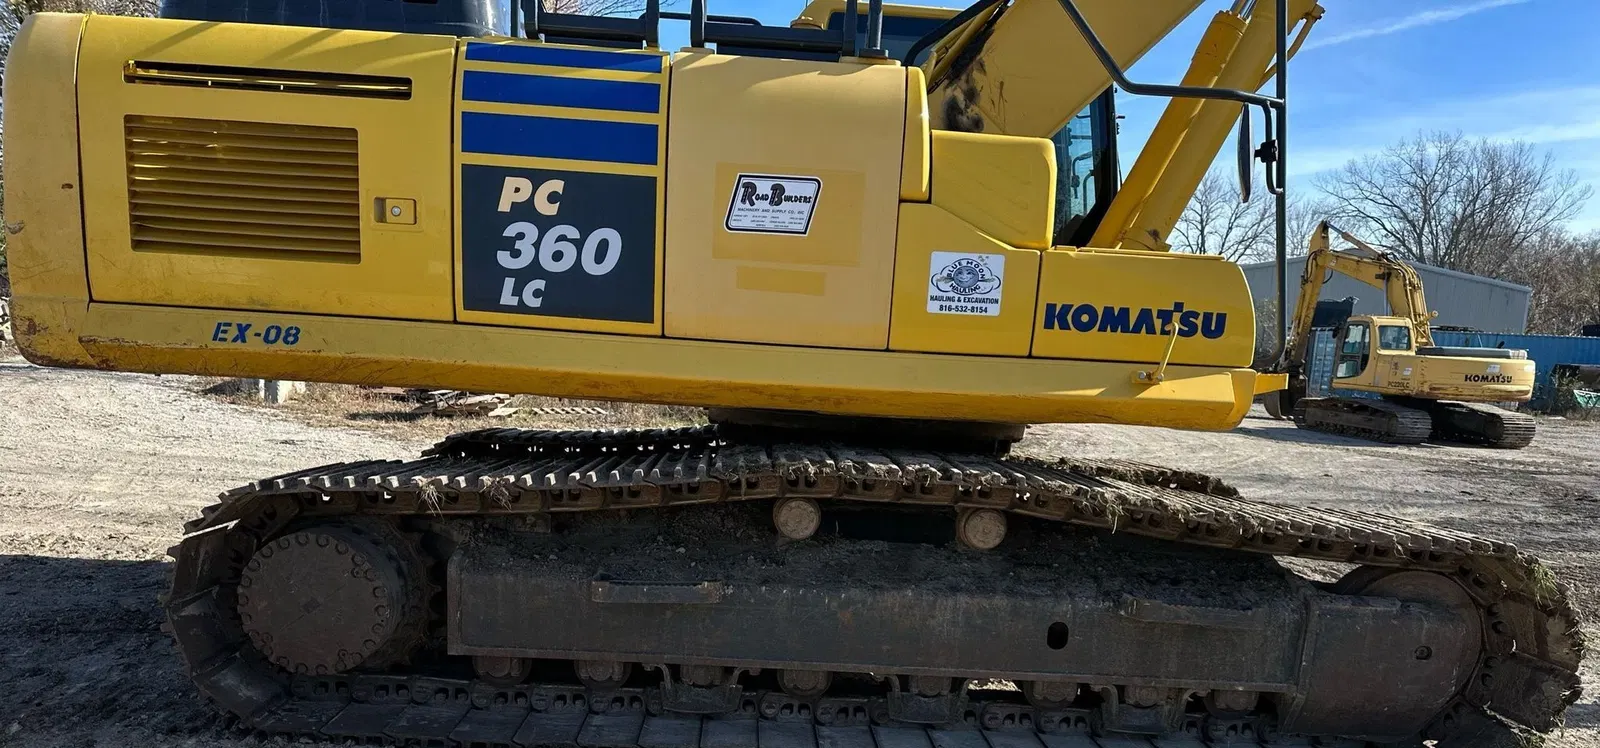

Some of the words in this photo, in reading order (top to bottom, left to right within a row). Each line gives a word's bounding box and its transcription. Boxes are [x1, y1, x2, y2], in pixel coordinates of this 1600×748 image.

[498, 176, 565, 216] PC
[496, 221, 622, 276] 360
[946, 261, 962, 278] BLUE
[966, 260, 985, 279] MOON
[499, 277, 546, 308] LC
[949, 283, 981, 293] HAULING
[939, 304, 988, 313] 816-532-8154
[1043, 302, 1227, 339] KOMATSU
[212, 322, 301, 345] EX-08
[1464, 374, 1513, 383] KOMATSU
